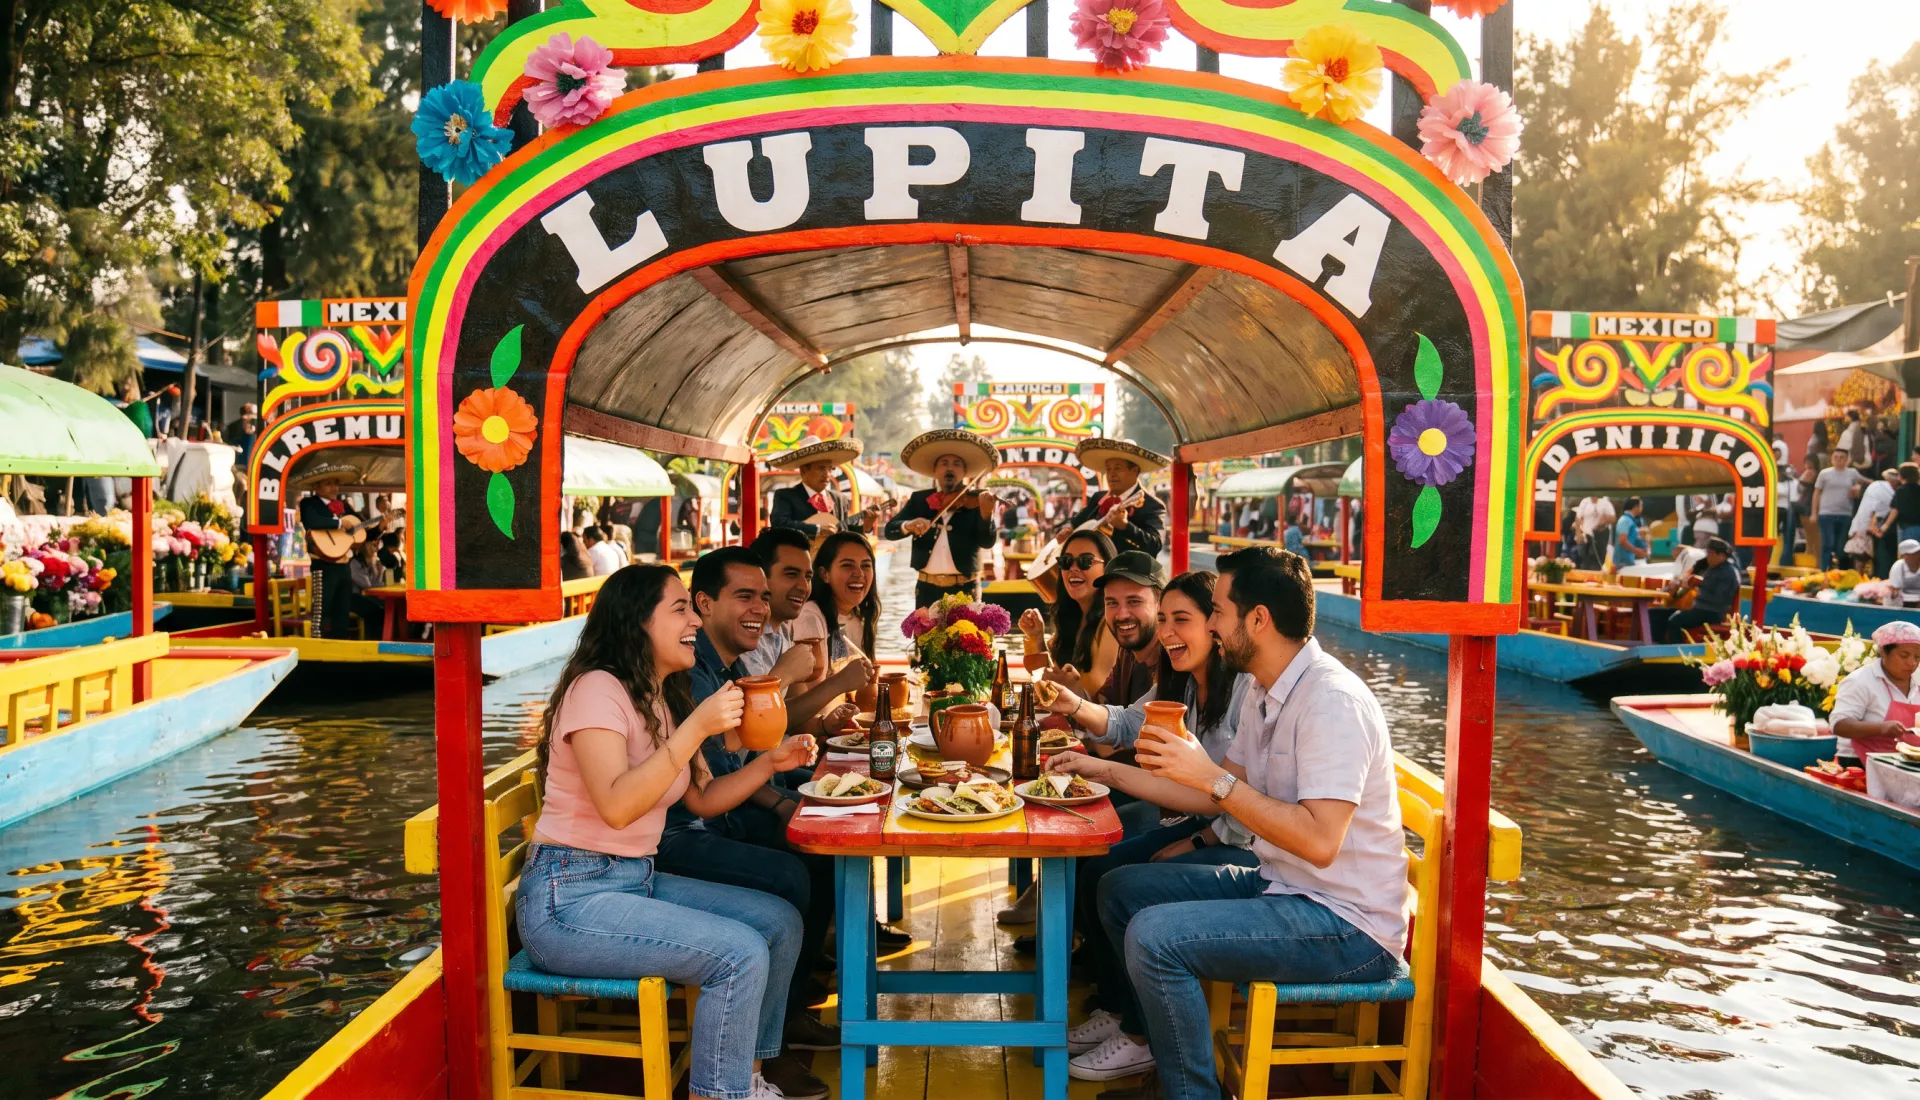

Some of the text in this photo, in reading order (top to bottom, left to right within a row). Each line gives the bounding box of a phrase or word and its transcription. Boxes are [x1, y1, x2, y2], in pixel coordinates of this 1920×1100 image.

[540, 126, 1392, 319] LUPITA
[1597, 317, 1712, 338] MEXICO
[259, 415, 401, 500] BLREMU
